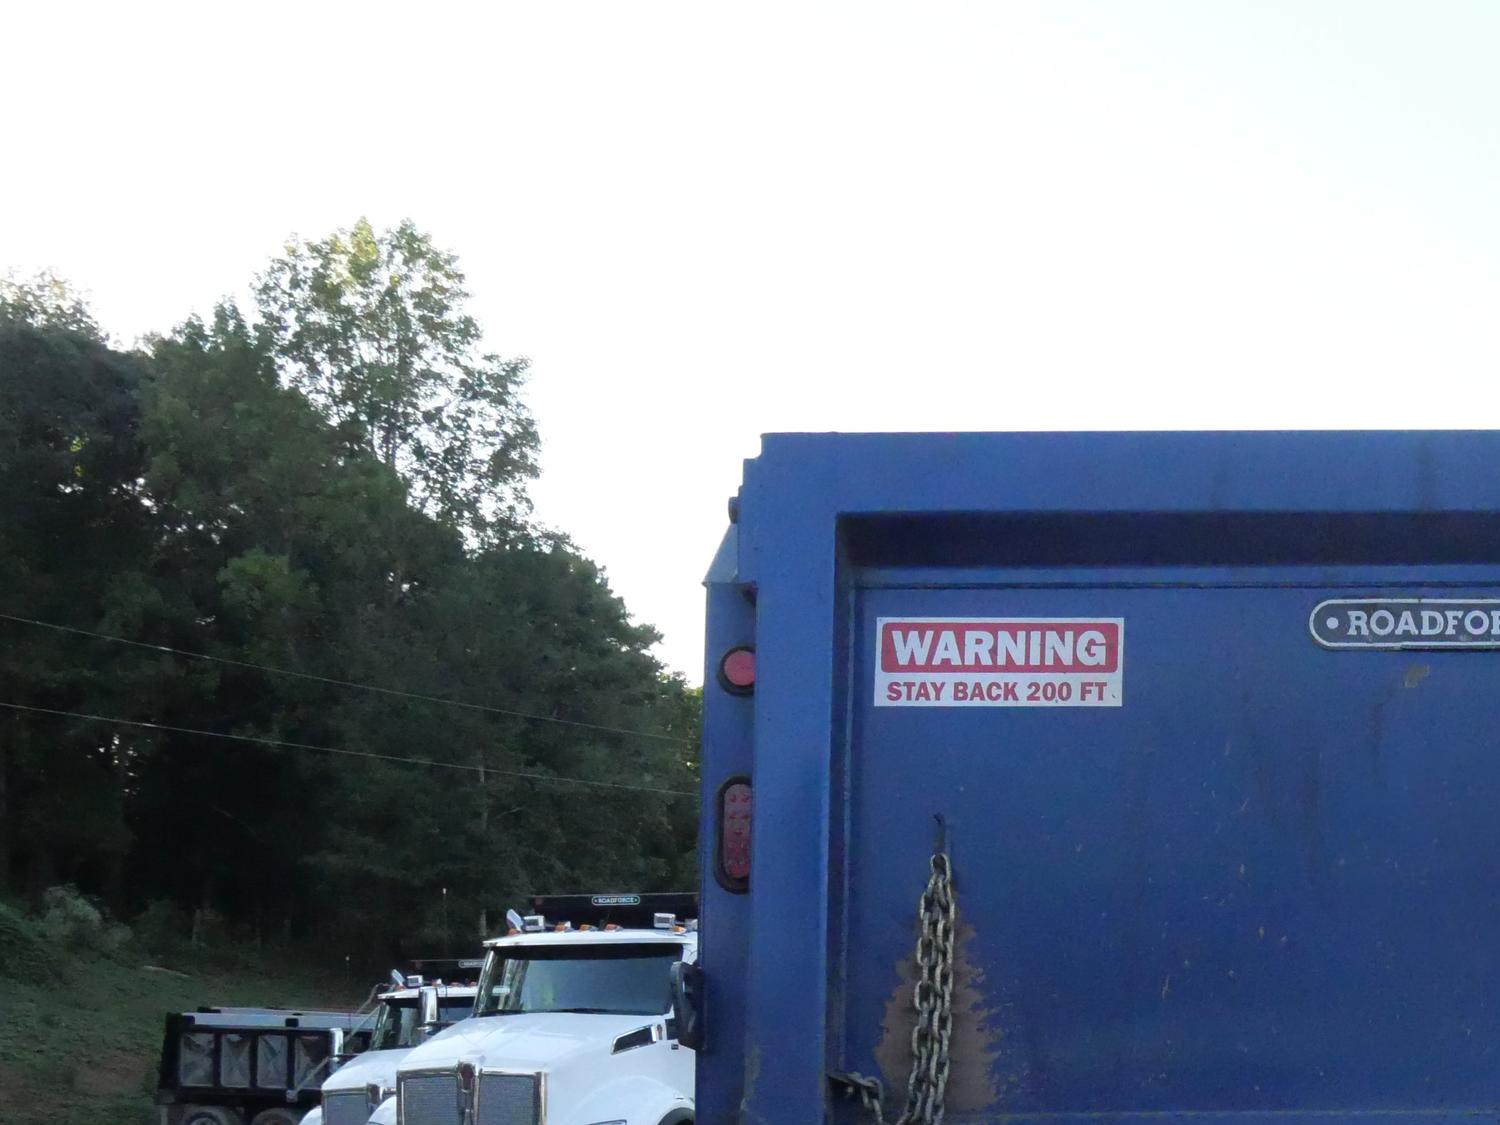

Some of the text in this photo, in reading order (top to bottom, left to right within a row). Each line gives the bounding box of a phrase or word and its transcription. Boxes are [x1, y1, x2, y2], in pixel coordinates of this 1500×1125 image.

[891, 630, 1107, 666] WARNING
[886, 681, 1108, 701] STAY BACK 200 FT
